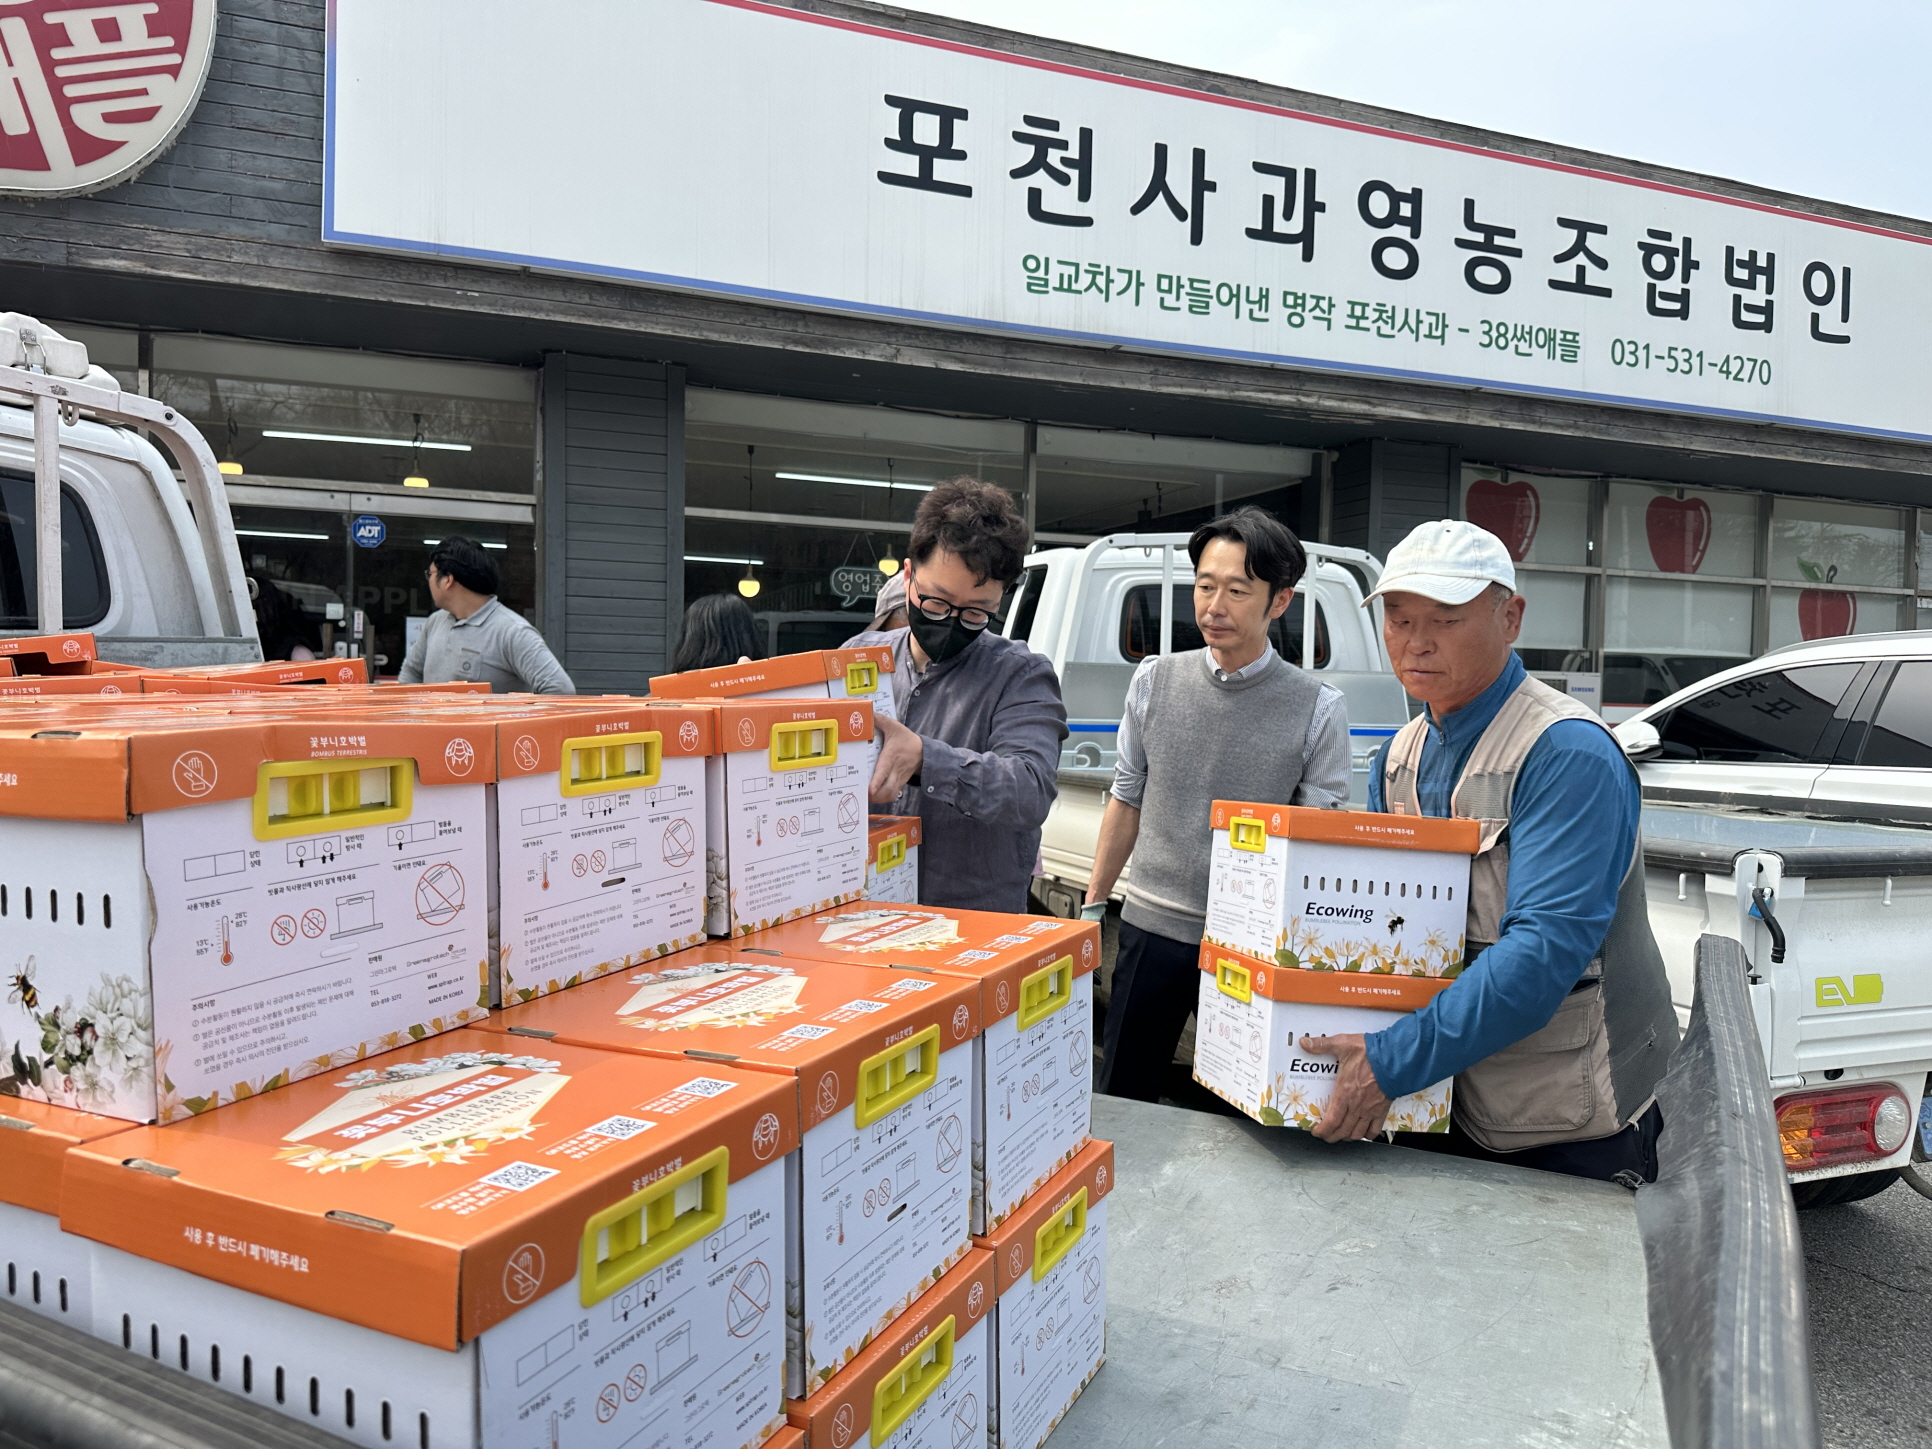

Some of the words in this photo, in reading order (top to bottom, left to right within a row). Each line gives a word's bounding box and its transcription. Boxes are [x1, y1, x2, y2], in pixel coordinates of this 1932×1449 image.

[877, 93, 1852, 346] 포천사과영농조합법인
[1022, 254, 1145, 306] 일교차가
[1156, 273, 1269, 323] 만들어낸
[1282, 289, 1336, 332] 명작
[1344, 300, 1449, 346] 포천사과
[1479, 320, 1581, 363] 38썬애플
[1611, 338, 1772, 386] 031-531-4270
[357, 525, 381, 538] ADT
[839, 572, 883, 593] 영업중
[1571, 686, 1595, 694] SAMSUNG
[595, 722, 630, 733] 꽃부니호박벌
[309, 735, 367, 749] 꽃부니호박벌
[1354, 824, 1364, 832] 사용
[1372, 826, 1386, 834] 반드시
[1305, 902, 1374, 923] Ecowing
[652, 976, 764, 1014] 꽃부니호박벌
[1815, 974, 1870, 1007] EV
[1290, 1058, 1339, 1074] Ecowi
[333, 1074, 515, 1140] 꽃부니호박벌
[401, 1088, 518, 1136] BUMBLEBEE
[412, 1088, 543, 1142] POLLINATION
[460, 1114, 502, 1132] SINCE
[184, 1226, 202, 1244] 사용
[205, 1232, 215, 1247] 후
[218, 1235, 247, 1257] 반드시
[250, 1242, 310, 1273] 폐기해주세요
